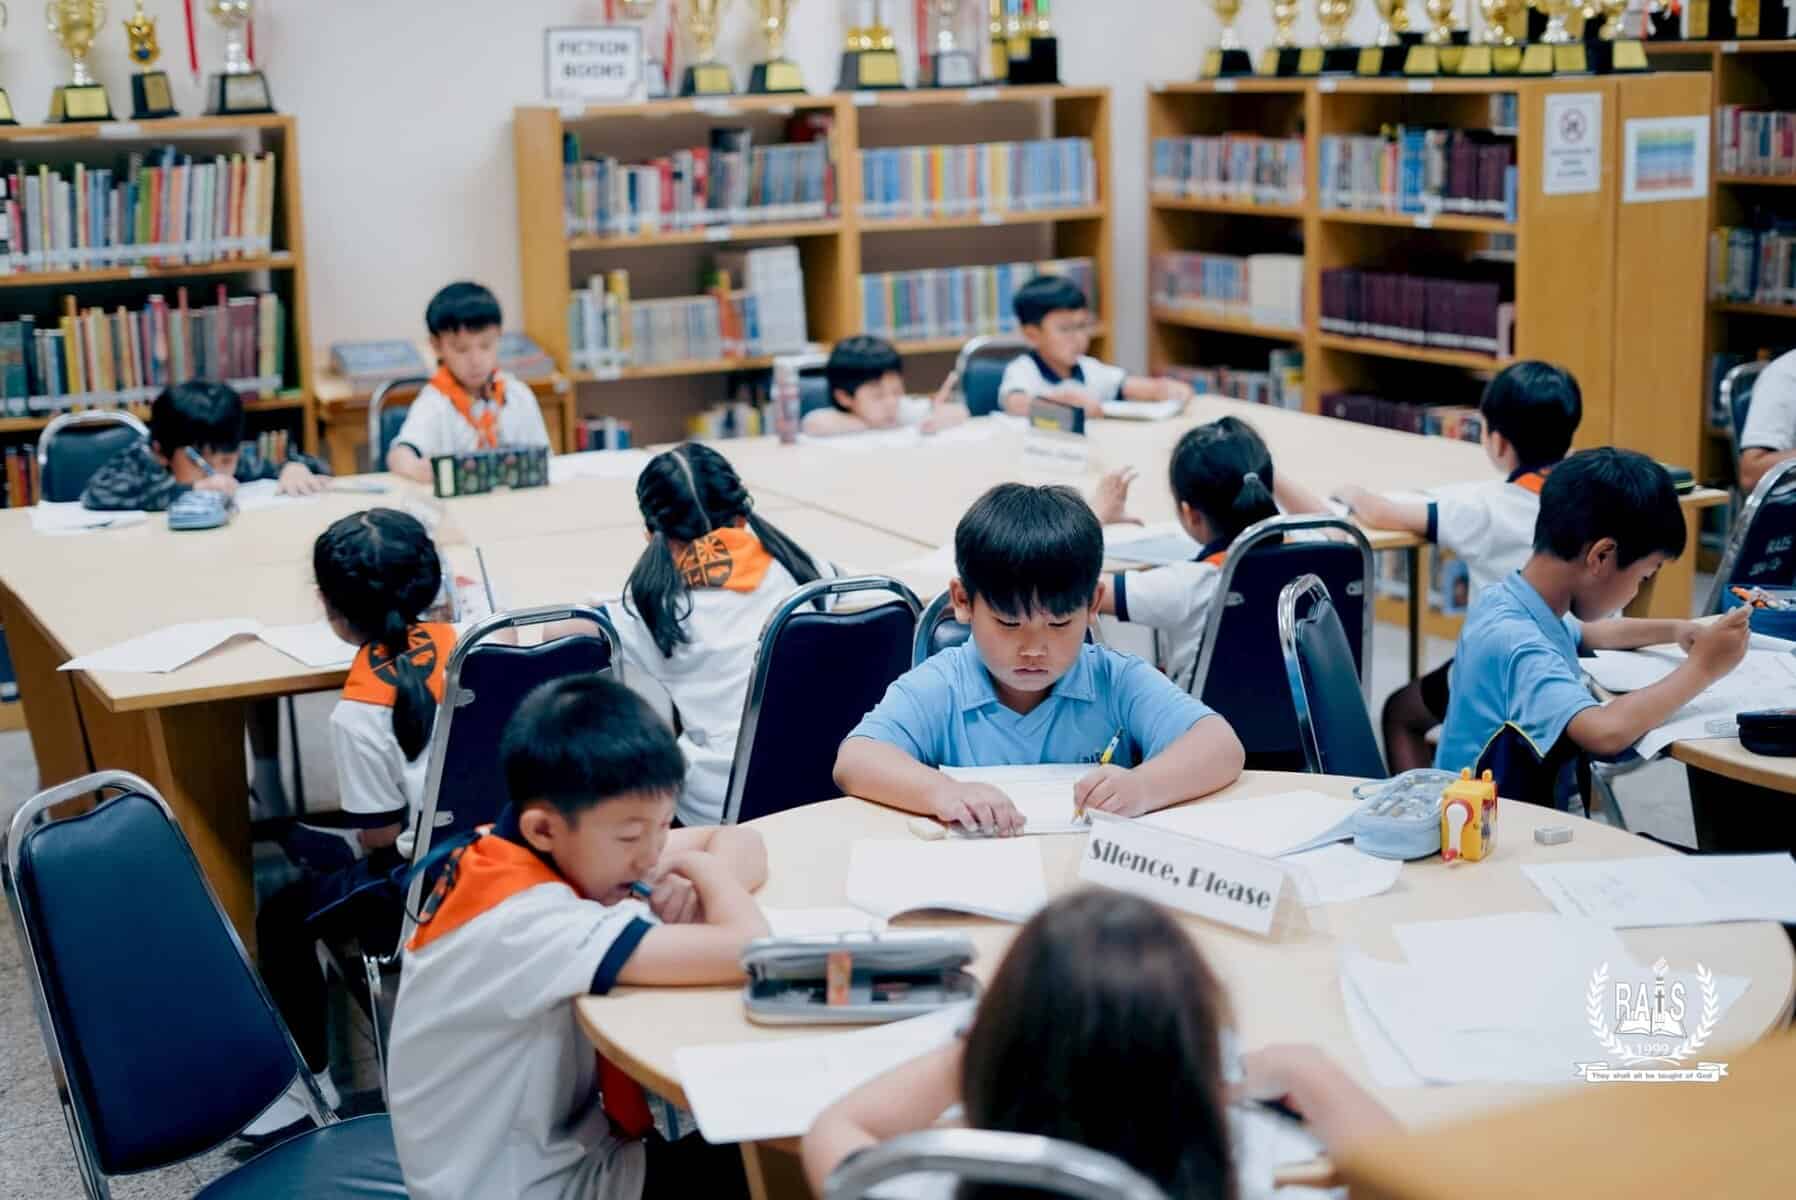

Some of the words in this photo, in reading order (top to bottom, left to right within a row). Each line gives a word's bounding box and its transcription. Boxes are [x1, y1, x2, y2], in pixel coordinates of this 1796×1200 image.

[558, 41, 629, 56] FICTION
[564, 63, 625, 79] BOOKS
[1089, 838, 1180, 885] Silence,
[1187, 866, 1271, 909] Please
